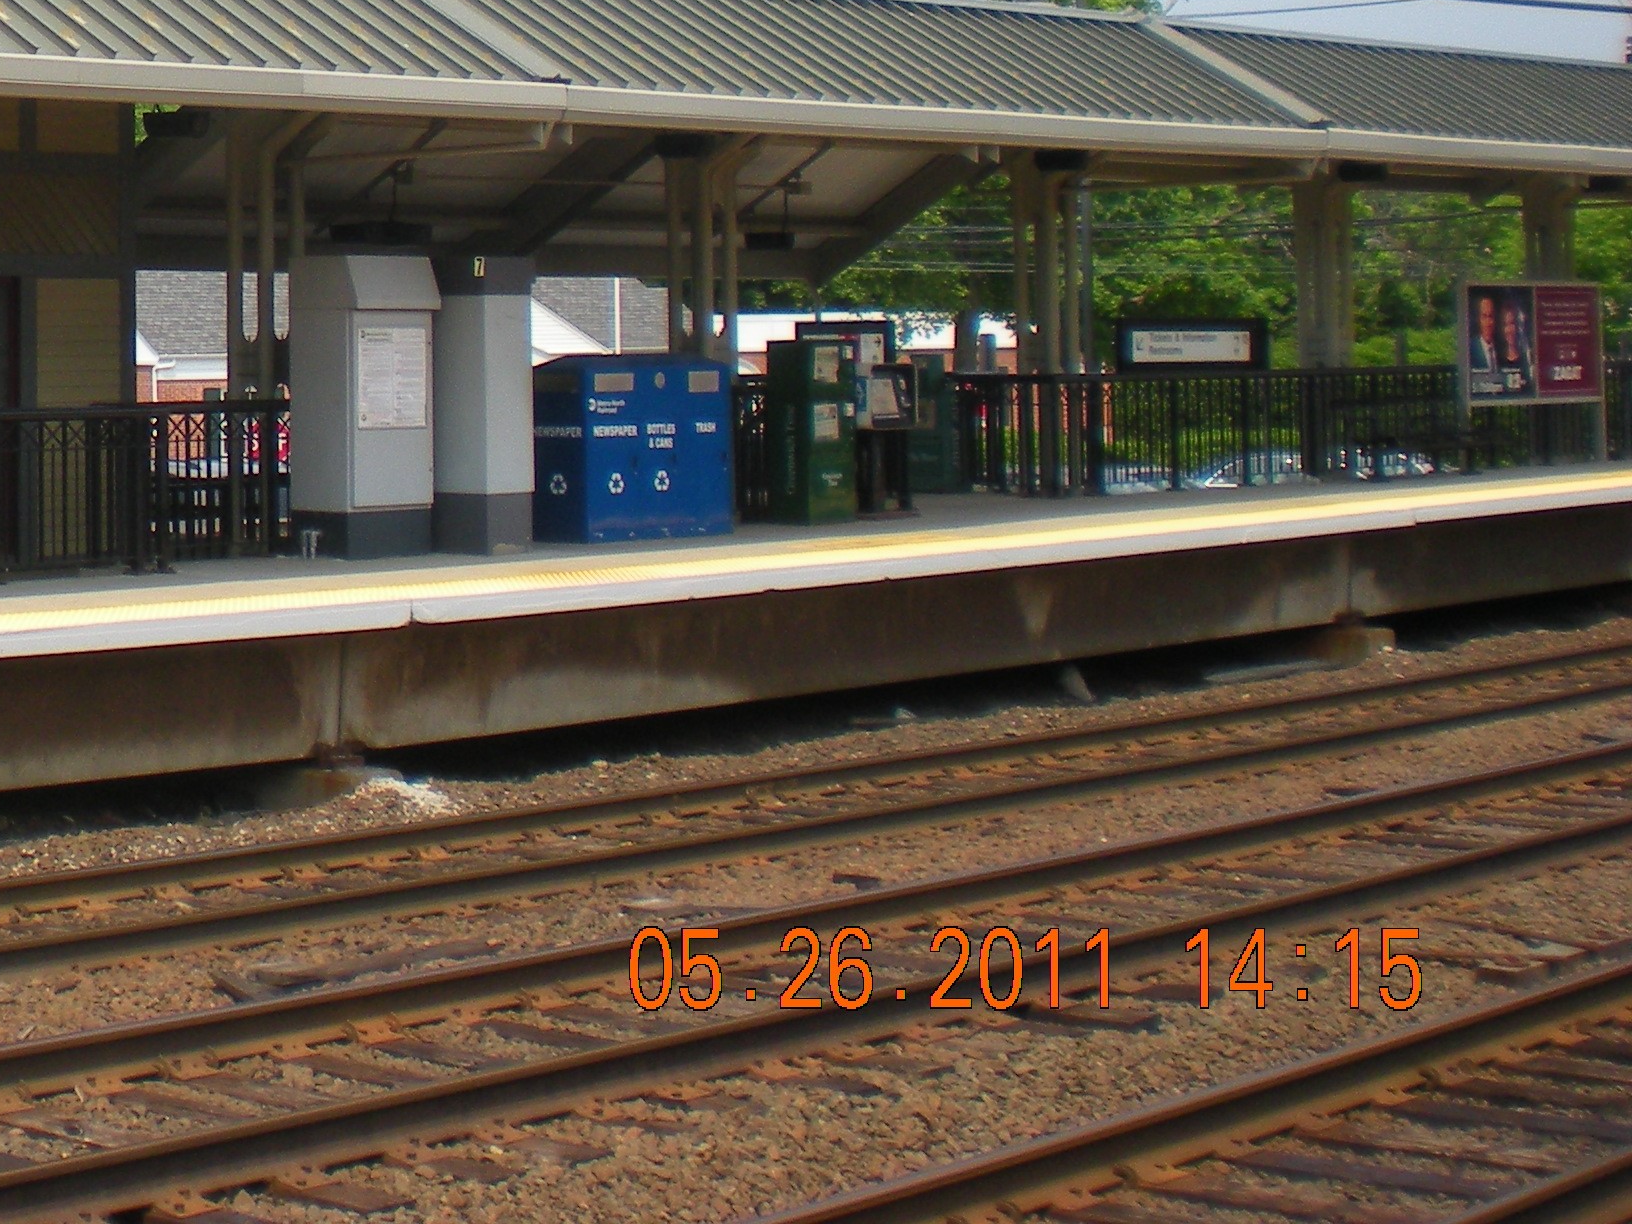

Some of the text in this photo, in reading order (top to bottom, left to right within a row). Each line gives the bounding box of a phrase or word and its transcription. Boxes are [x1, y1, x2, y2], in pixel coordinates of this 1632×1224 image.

[593, 425, 638, 438] NEWSPAPER
[646, 423, 676, 435] BOTTLES
[695, 422, 717, 433] TRASH
[655, 437, 674, 449] CANS
